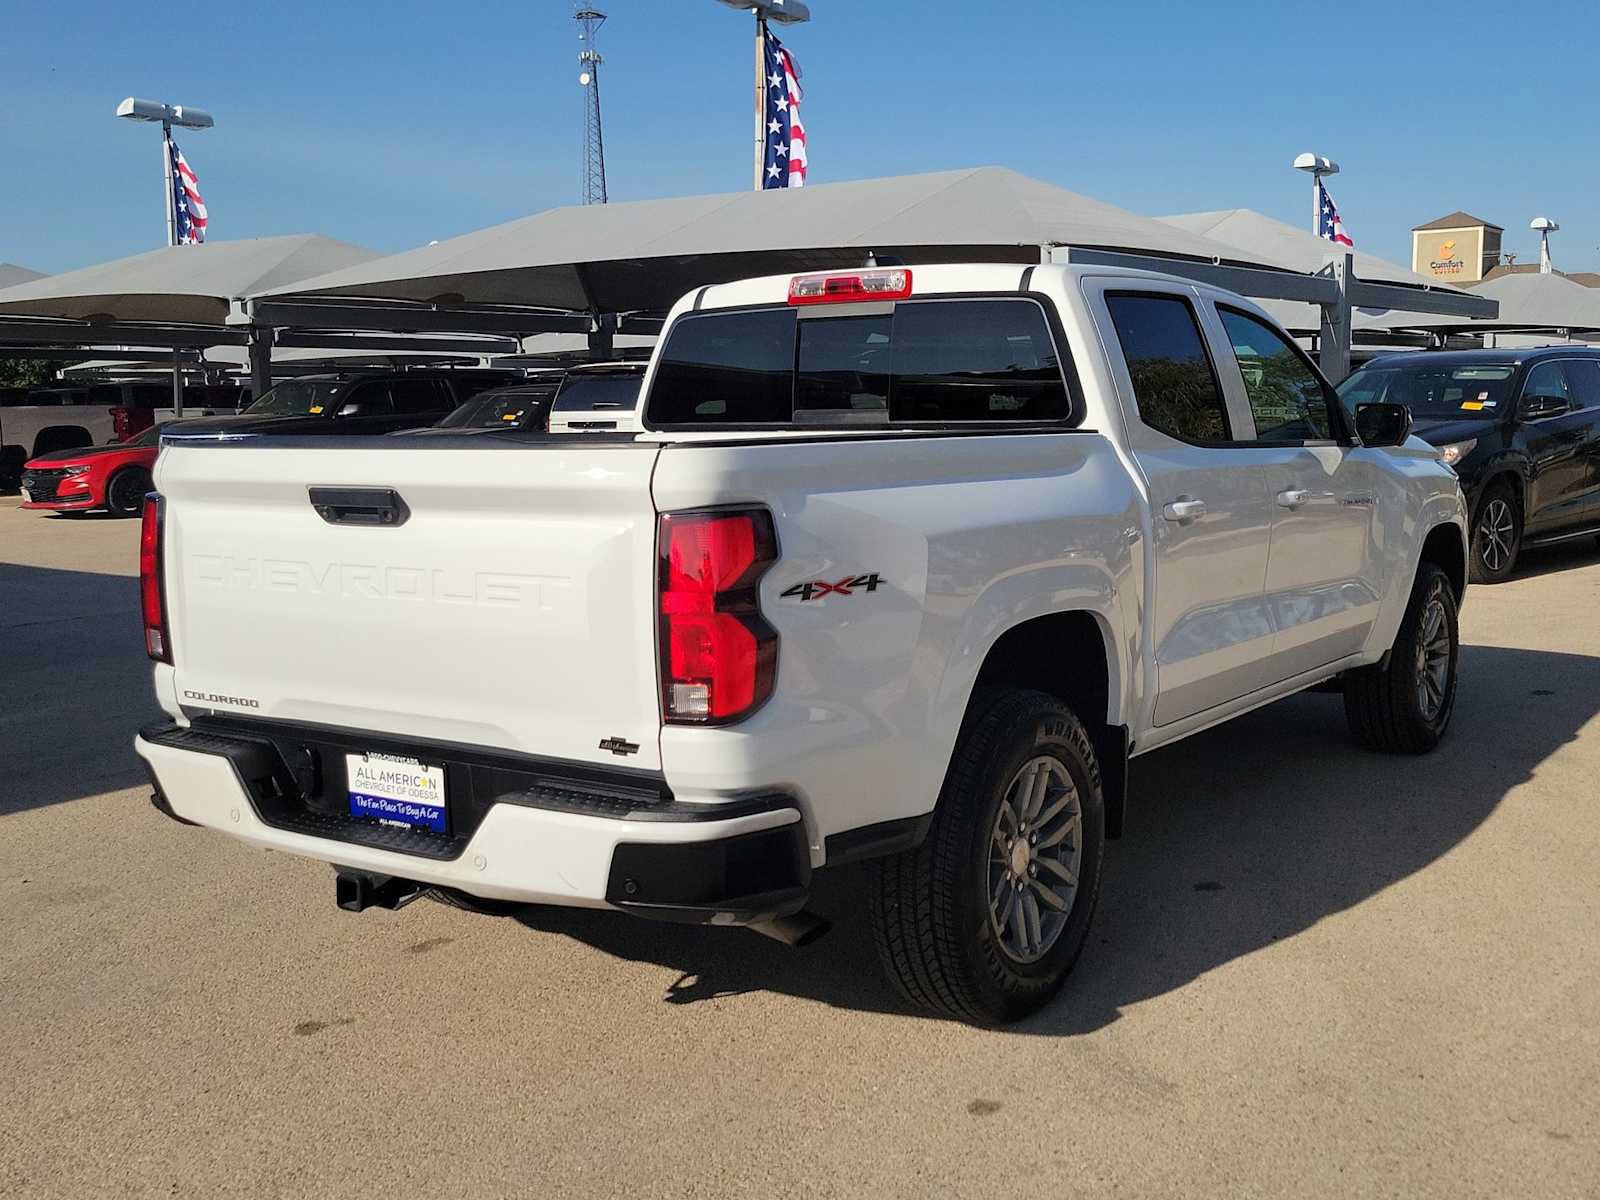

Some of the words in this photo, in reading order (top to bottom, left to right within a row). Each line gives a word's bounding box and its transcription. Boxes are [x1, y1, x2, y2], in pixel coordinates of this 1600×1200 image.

[1430, 260, 1464, 269] Comfort
[191, 554, 572, 610] CHEVROLET
[184, 690, 259, 708] COLORADO
[356, 767, 377, 780] ALL
[354, 779, 395, 793] CHEVROLET
[396, 785, 406, 795] OF
[407, 788, 440, 801] ODESSA
[355, 796, 368, 808] The
[379, 799, 398, 812] Place
[397, 801, 406, 814] To
[419, 807, 427, 818] A
[426, 808, 440, 820] Car
